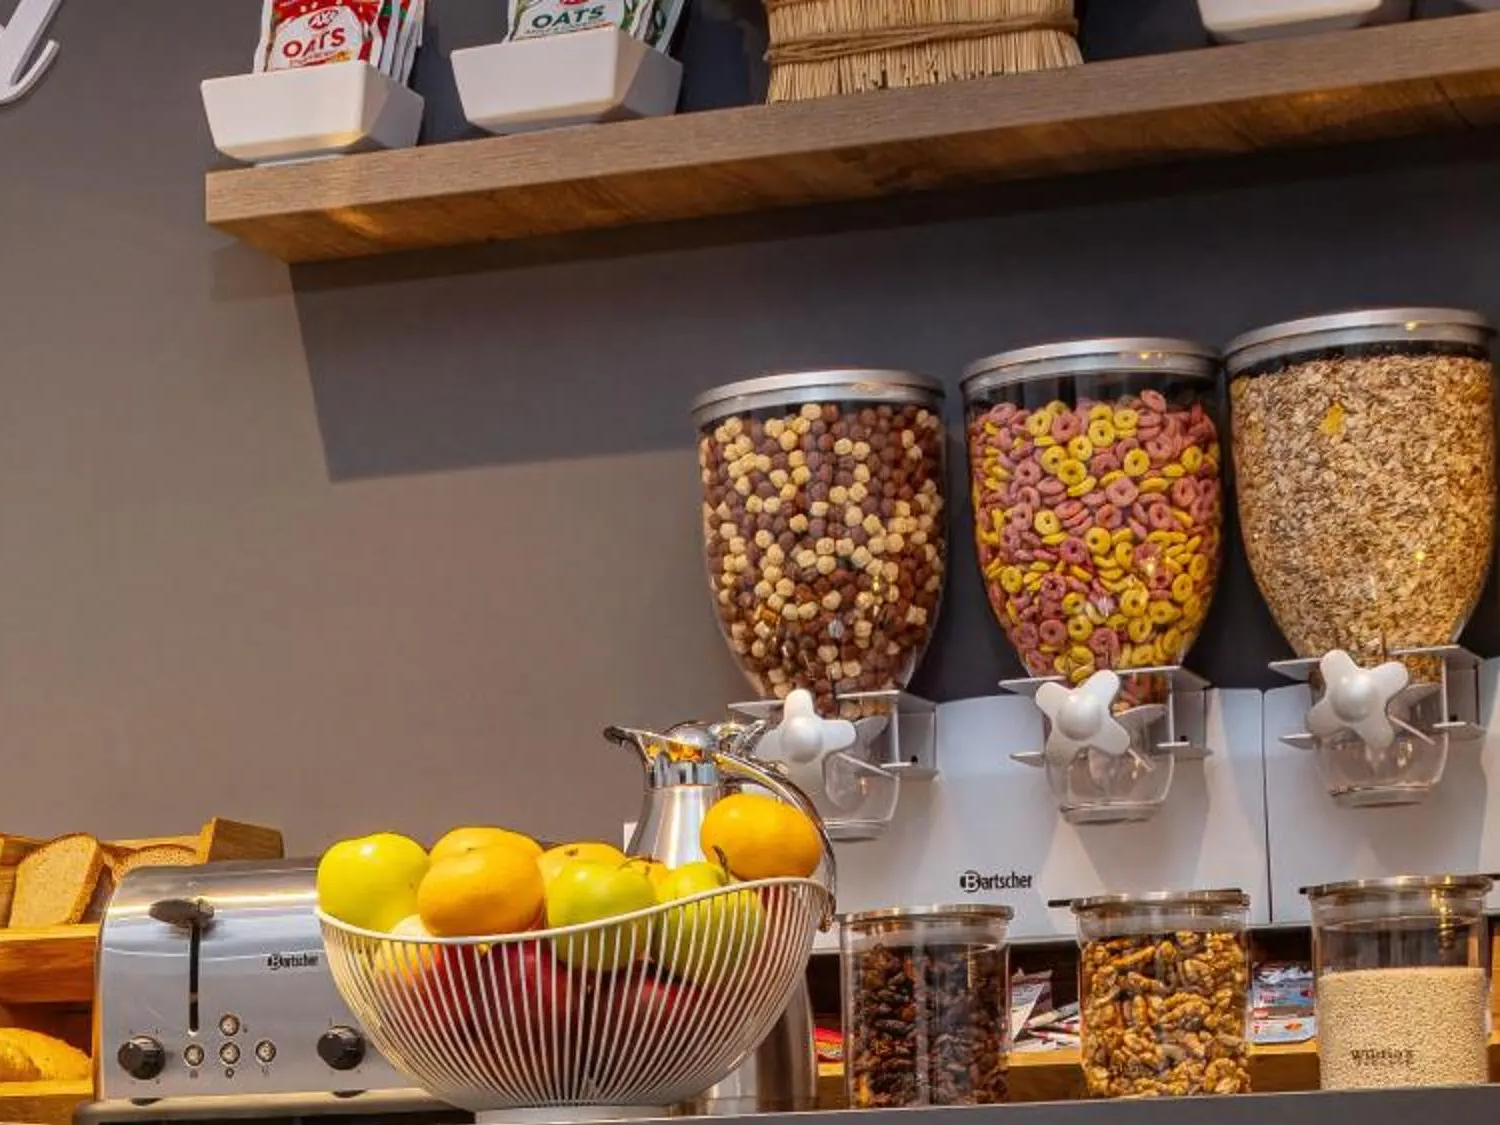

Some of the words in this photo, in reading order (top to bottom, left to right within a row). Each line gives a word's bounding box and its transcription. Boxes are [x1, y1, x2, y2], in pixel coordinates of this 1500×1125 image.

[532, 4, 606, 28] OATS
[283, 27, 345, 58] OATS
[960, 869, 1032, 893] Bartscher
